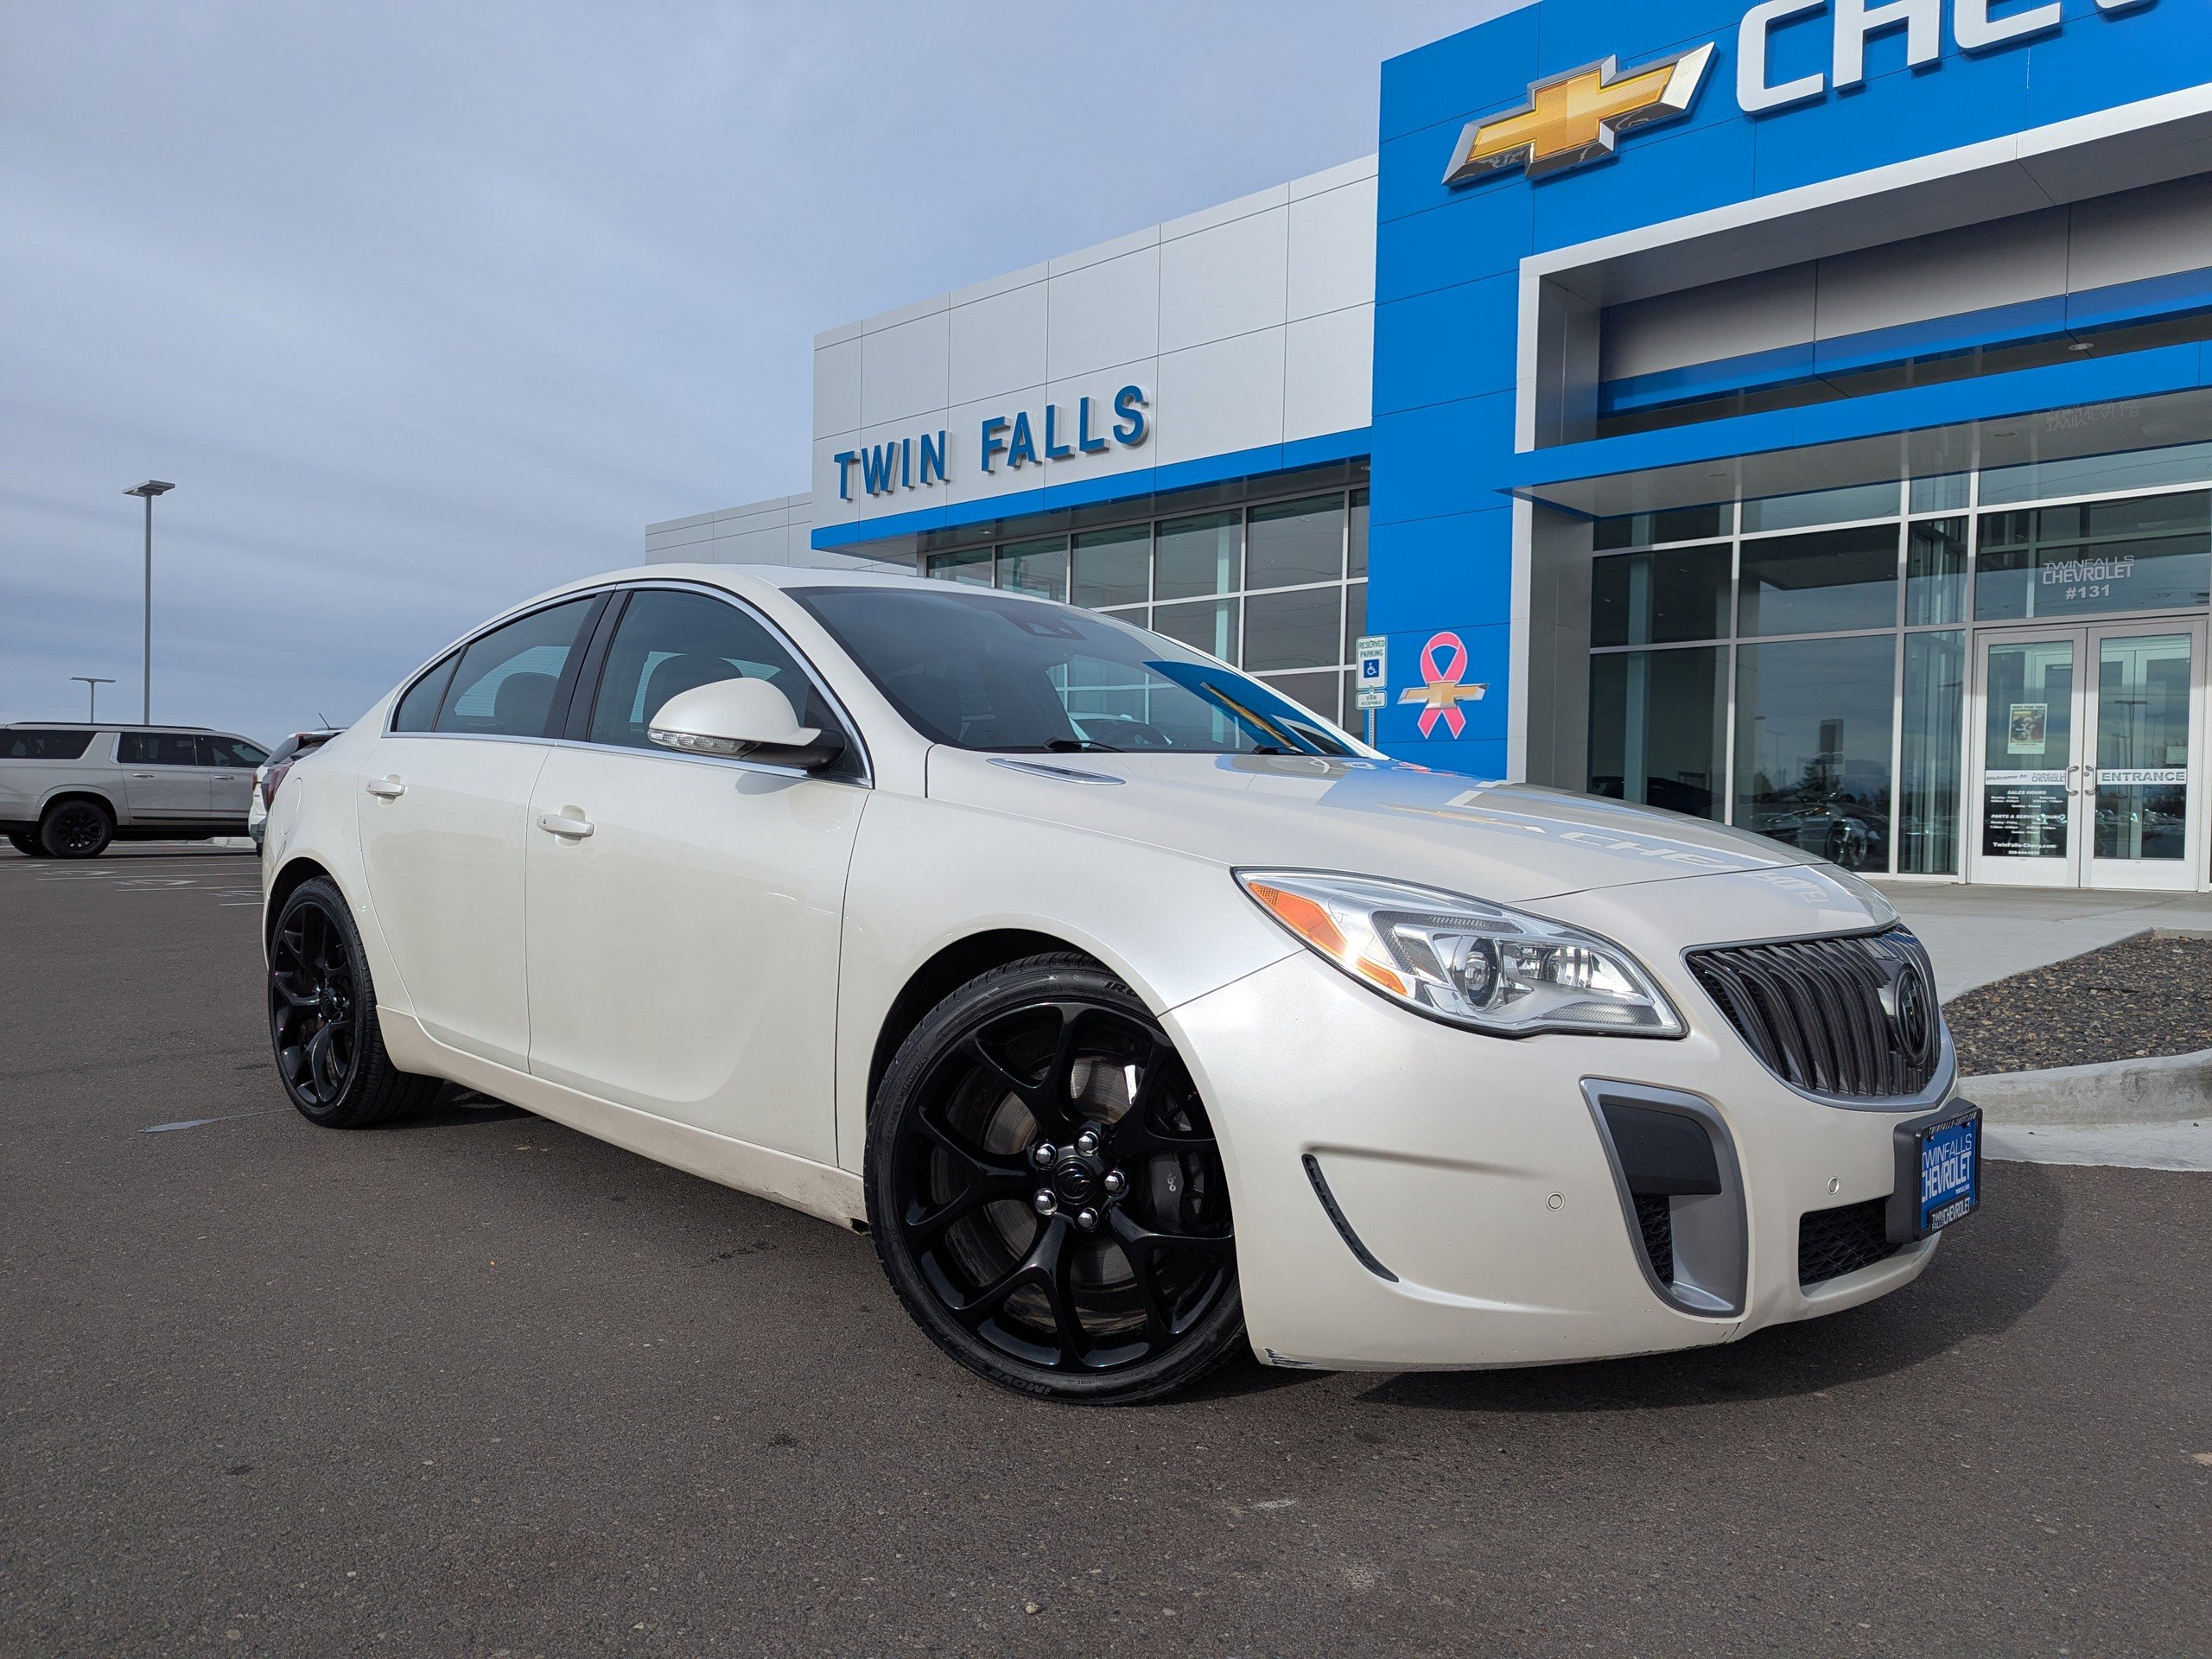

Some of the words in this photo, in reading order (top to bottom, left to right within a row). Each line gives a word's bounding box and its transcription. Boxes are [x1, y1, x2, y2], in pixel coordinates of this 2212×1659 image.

[834, 429, 950, 502] TWIN
[981, 385, 1149, 473] FALLS
[2043, 555, 2134, 570] TWINFALLS
[2043, 563, 2134, 585] CHEVROLET
[2065, 584, 2110, 600] #131
[1358, 640, 1384, 649] RESERVED
[1360, 650, 1383, 658] PARKING
[2101, 772, 2185, 782] ENTRANCE
[1922, 1133, 1973, 1171] TWINFALLS
[1922, 1153, 1972, 1203] CHEVROLET
[1943, 1197, 1971, 1225] CHEVROLET
